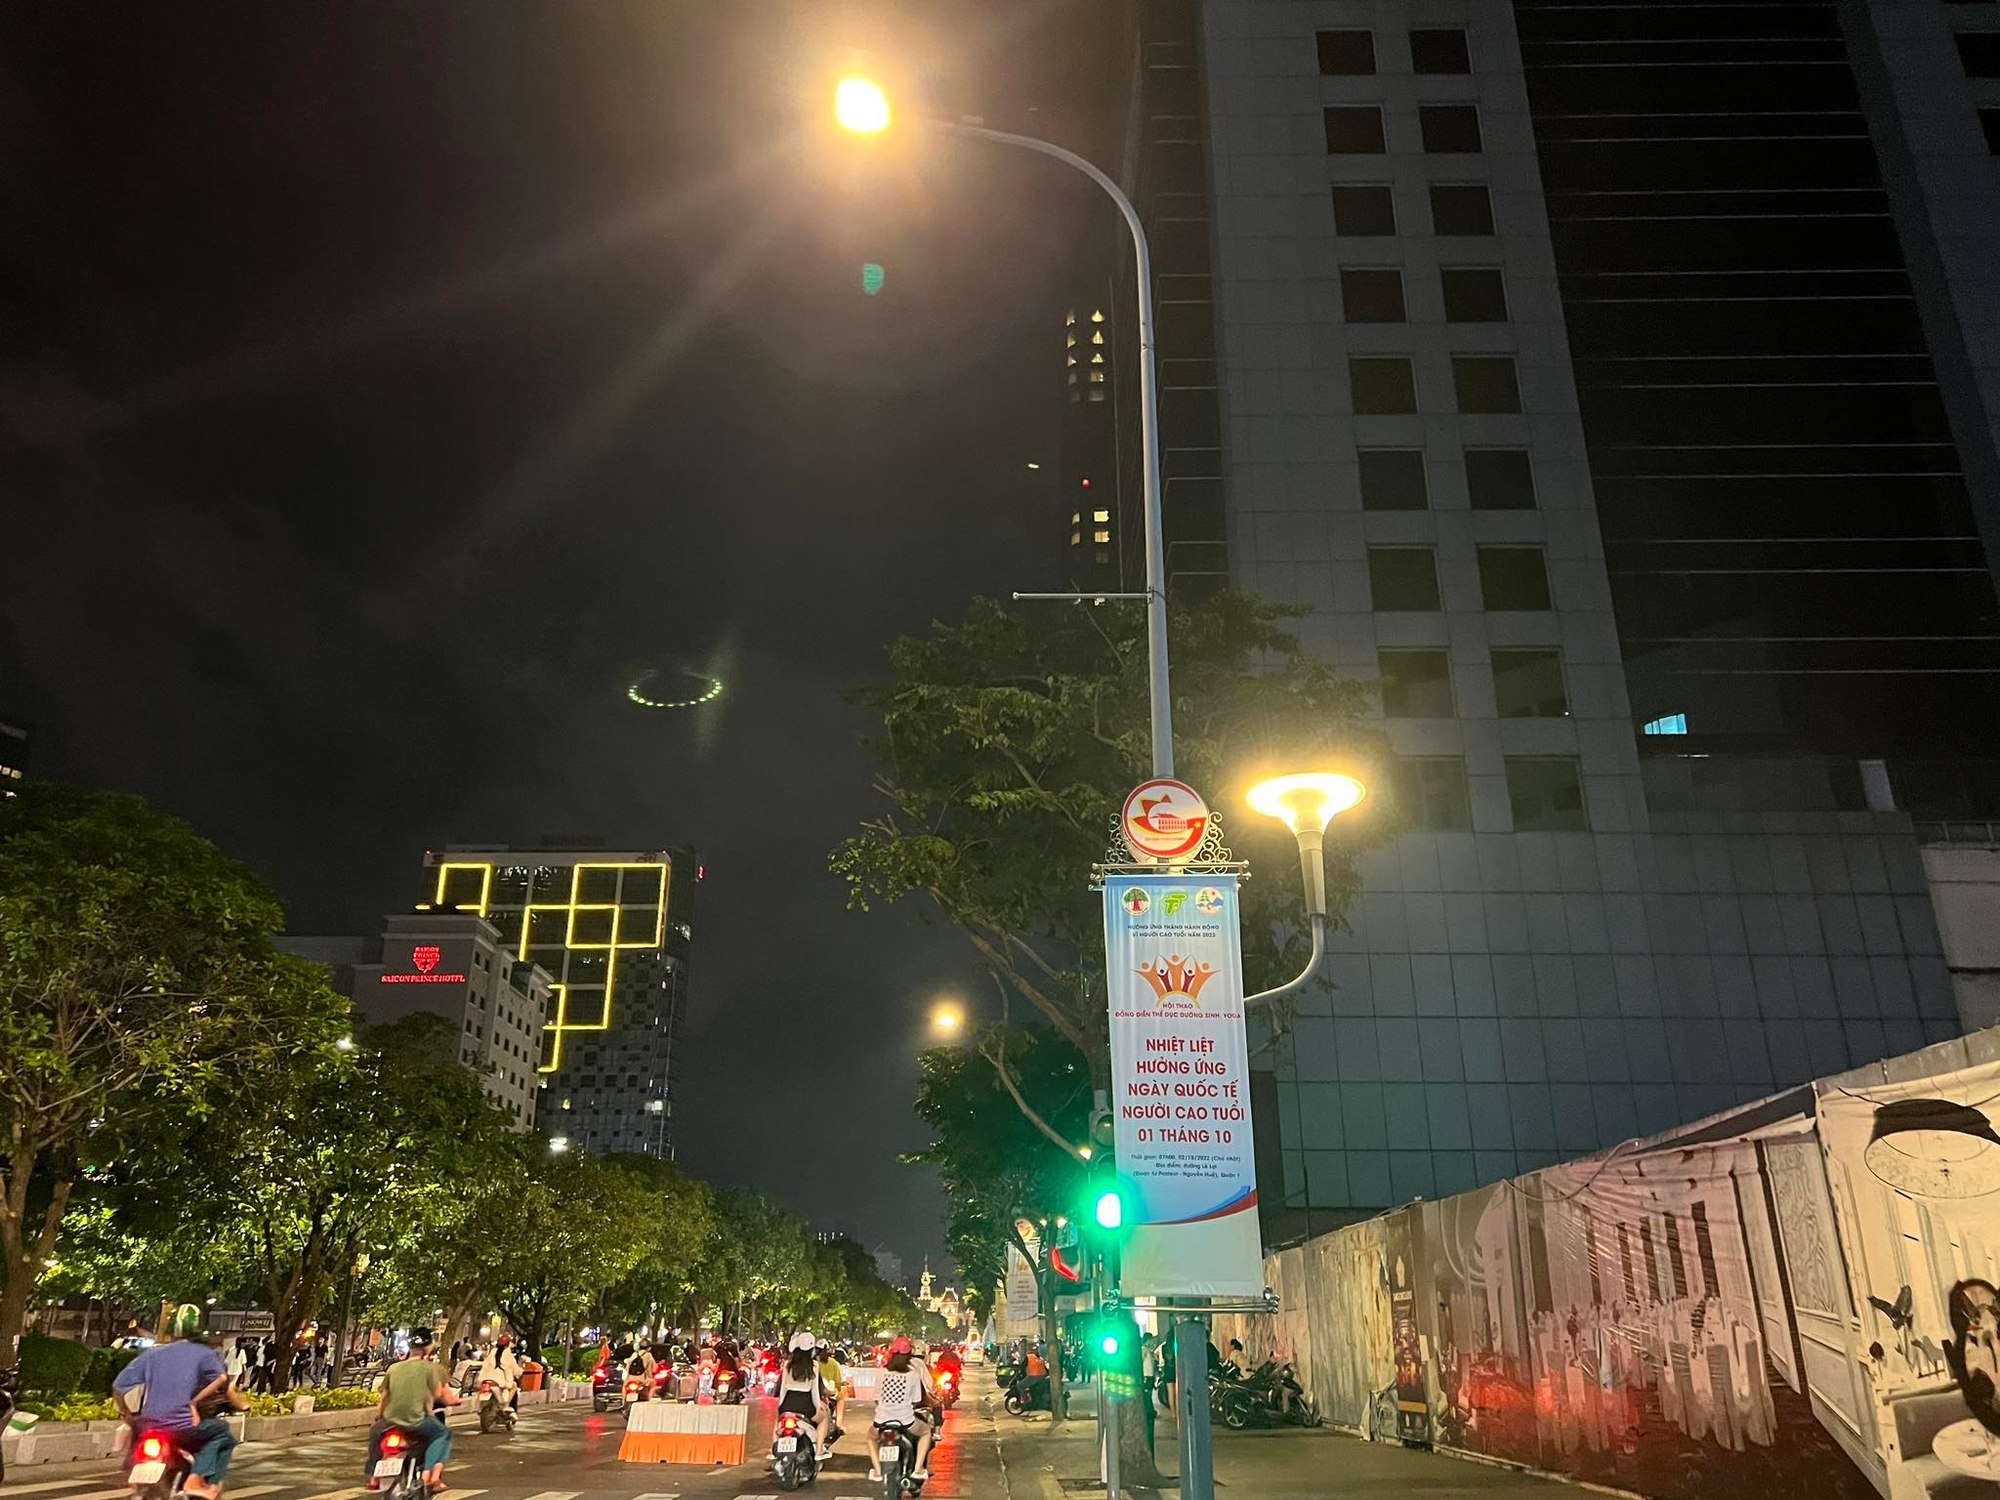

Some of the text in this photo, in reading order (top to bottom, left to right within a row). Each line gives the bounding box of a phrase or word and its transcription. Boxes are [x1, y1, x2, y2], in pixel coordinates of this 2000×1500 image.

[410, 974, 438, 982] PRINCE
[439, 974, 466, 982] HOTEL
[1146, 1036, 1214, 1056] NHIỆT LIỆT
[1136, 1056, 1226, 1075] HƯỞNG ỨNG
[1128, 1078, 1239, 1098] NGÀY QUỐC TẾ
[1122, 1100, 1244, 1121] NGƯỜI CAO TUỔI
[1138, 1125, 1232, 1144] 01 THÁNG 10
